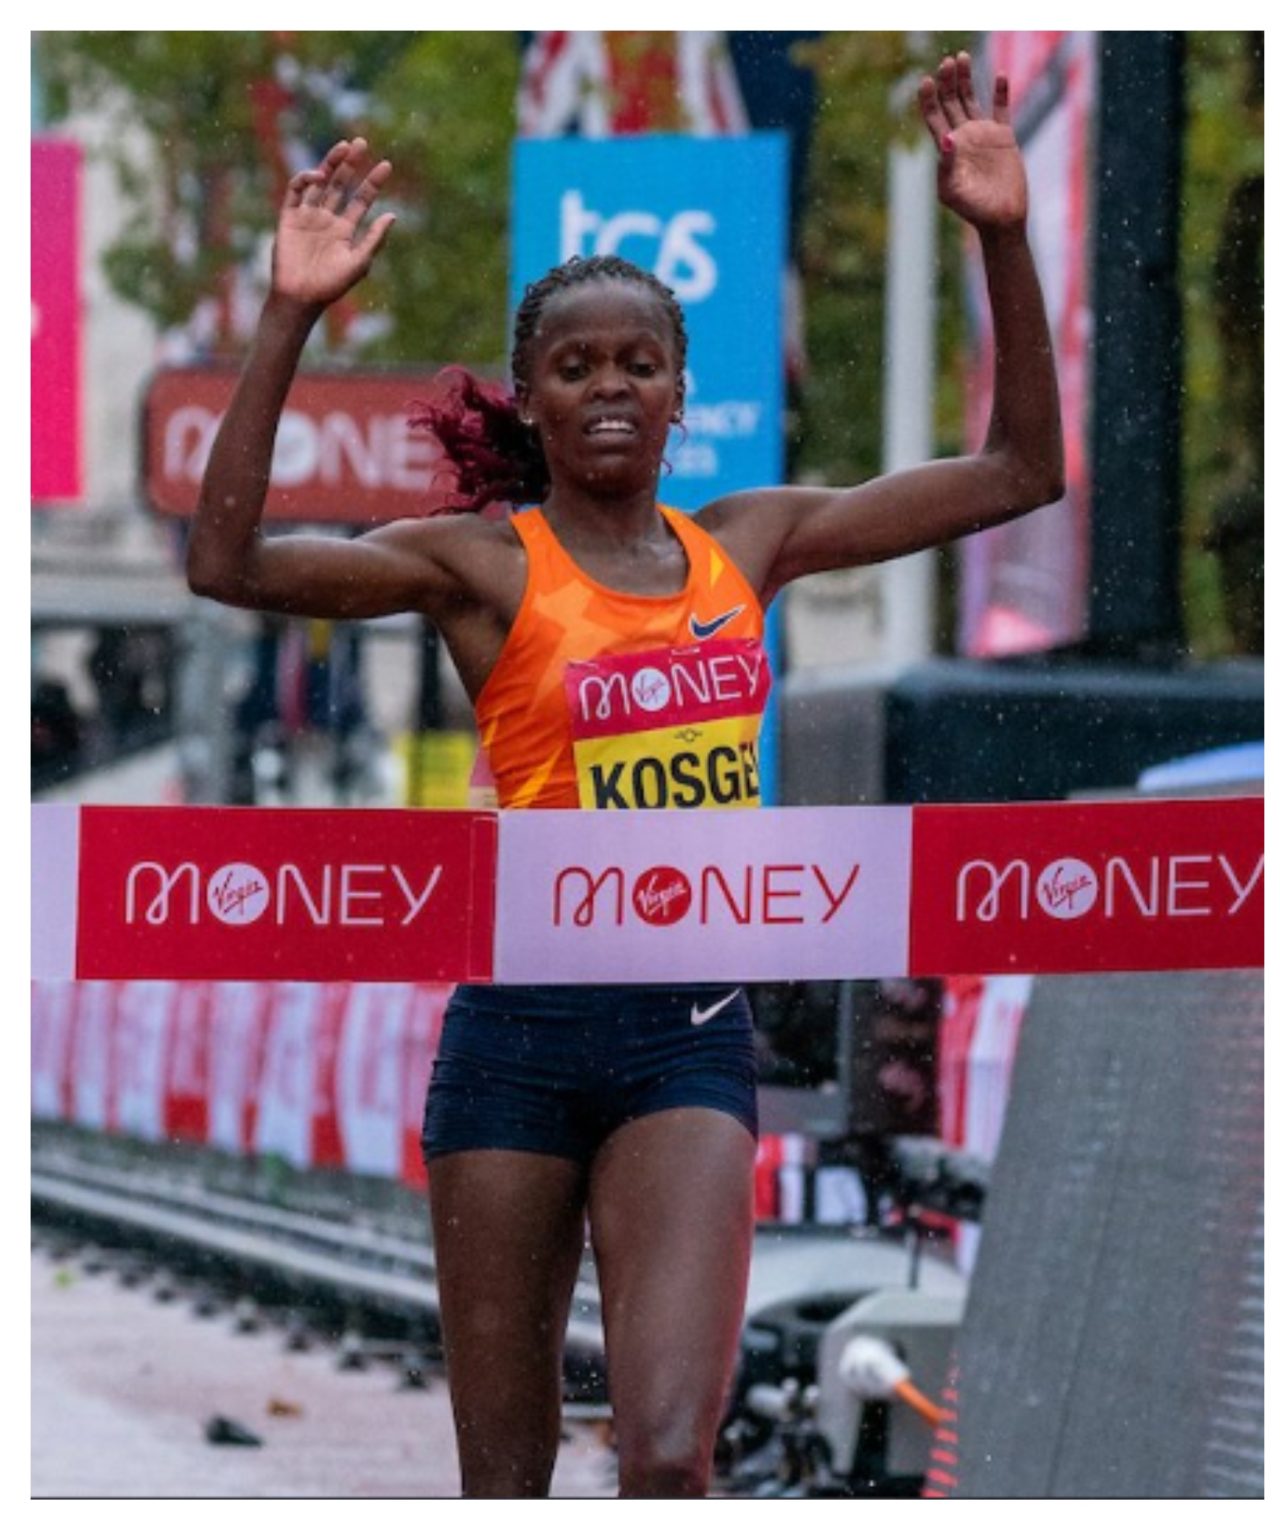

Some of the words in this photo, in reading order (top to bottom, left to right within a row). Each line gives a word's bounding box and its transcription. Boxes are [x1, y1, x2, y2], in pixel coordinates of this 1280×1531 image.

[560, 188, 719, 303] tcs
[163, 404, 438, 490] MONE
[579, 653, 763, 721] MONEY
[126, 861, 442, 925] MONEY
[211, 869, 265, 916] Virgin
[553, 863, 860, 927] MONEY
[635, 873, 689, 918] Virgin
[956, 853, 1264, 922] MONEY
[1041, 866, 1094, 911] Virgin
